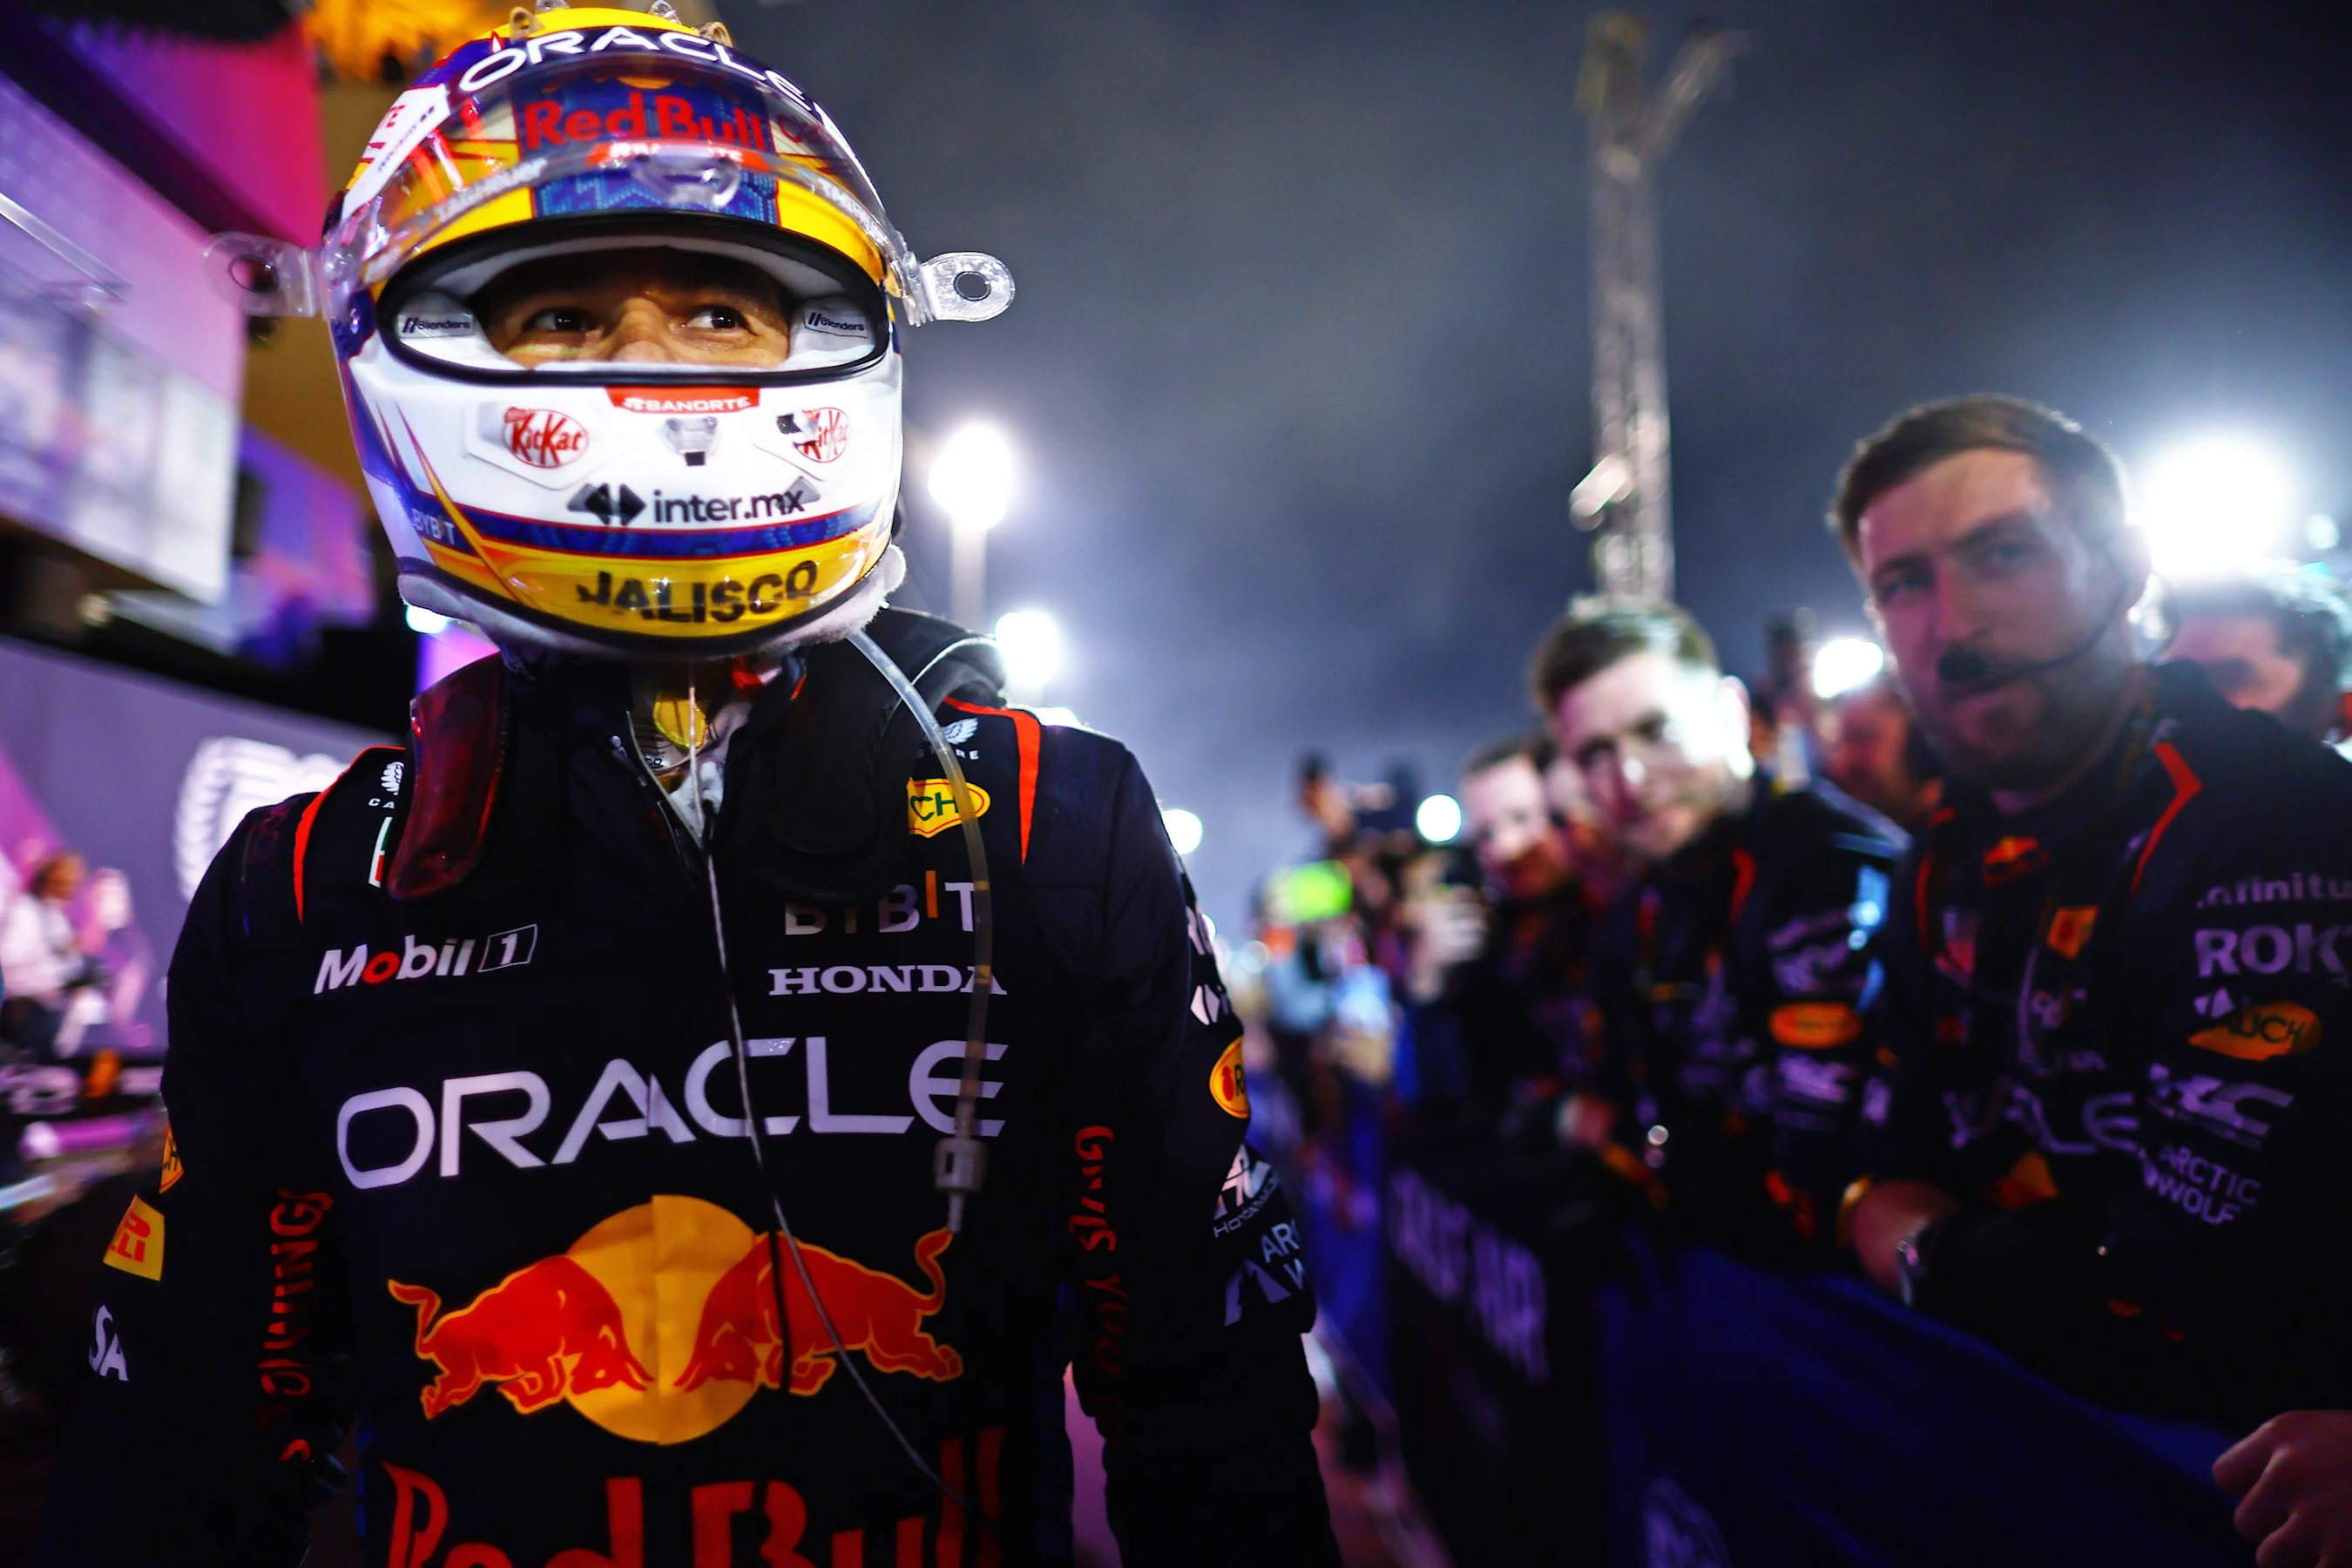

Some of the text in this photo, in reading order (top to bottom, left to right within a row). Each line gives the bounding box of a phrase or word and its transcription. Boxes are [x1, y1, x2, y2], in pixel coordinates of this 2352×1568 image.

[458, 26, 812, 112] ORACLE
[524, 91, 645, 151] Red
[655, 96, 767, 152] Bull
[644, 396, 751, 412] BANORTE
[511, 412, 583, 465] KitKat
[411, 508, 456, 545] BYBIT
[653, 490, 806, 523] inter.mx
[575, 560, 819, 623] JALISCO
[314, 932, 519, 995] Mobil 1
[767, 964, 1008, 996] HONDA
[336, 1036, 1010, 1190] ORACLE
[2158, 1175, 2241, 1226] WOLF
[2159, 1145, 2261, 1205] ARCTIC
